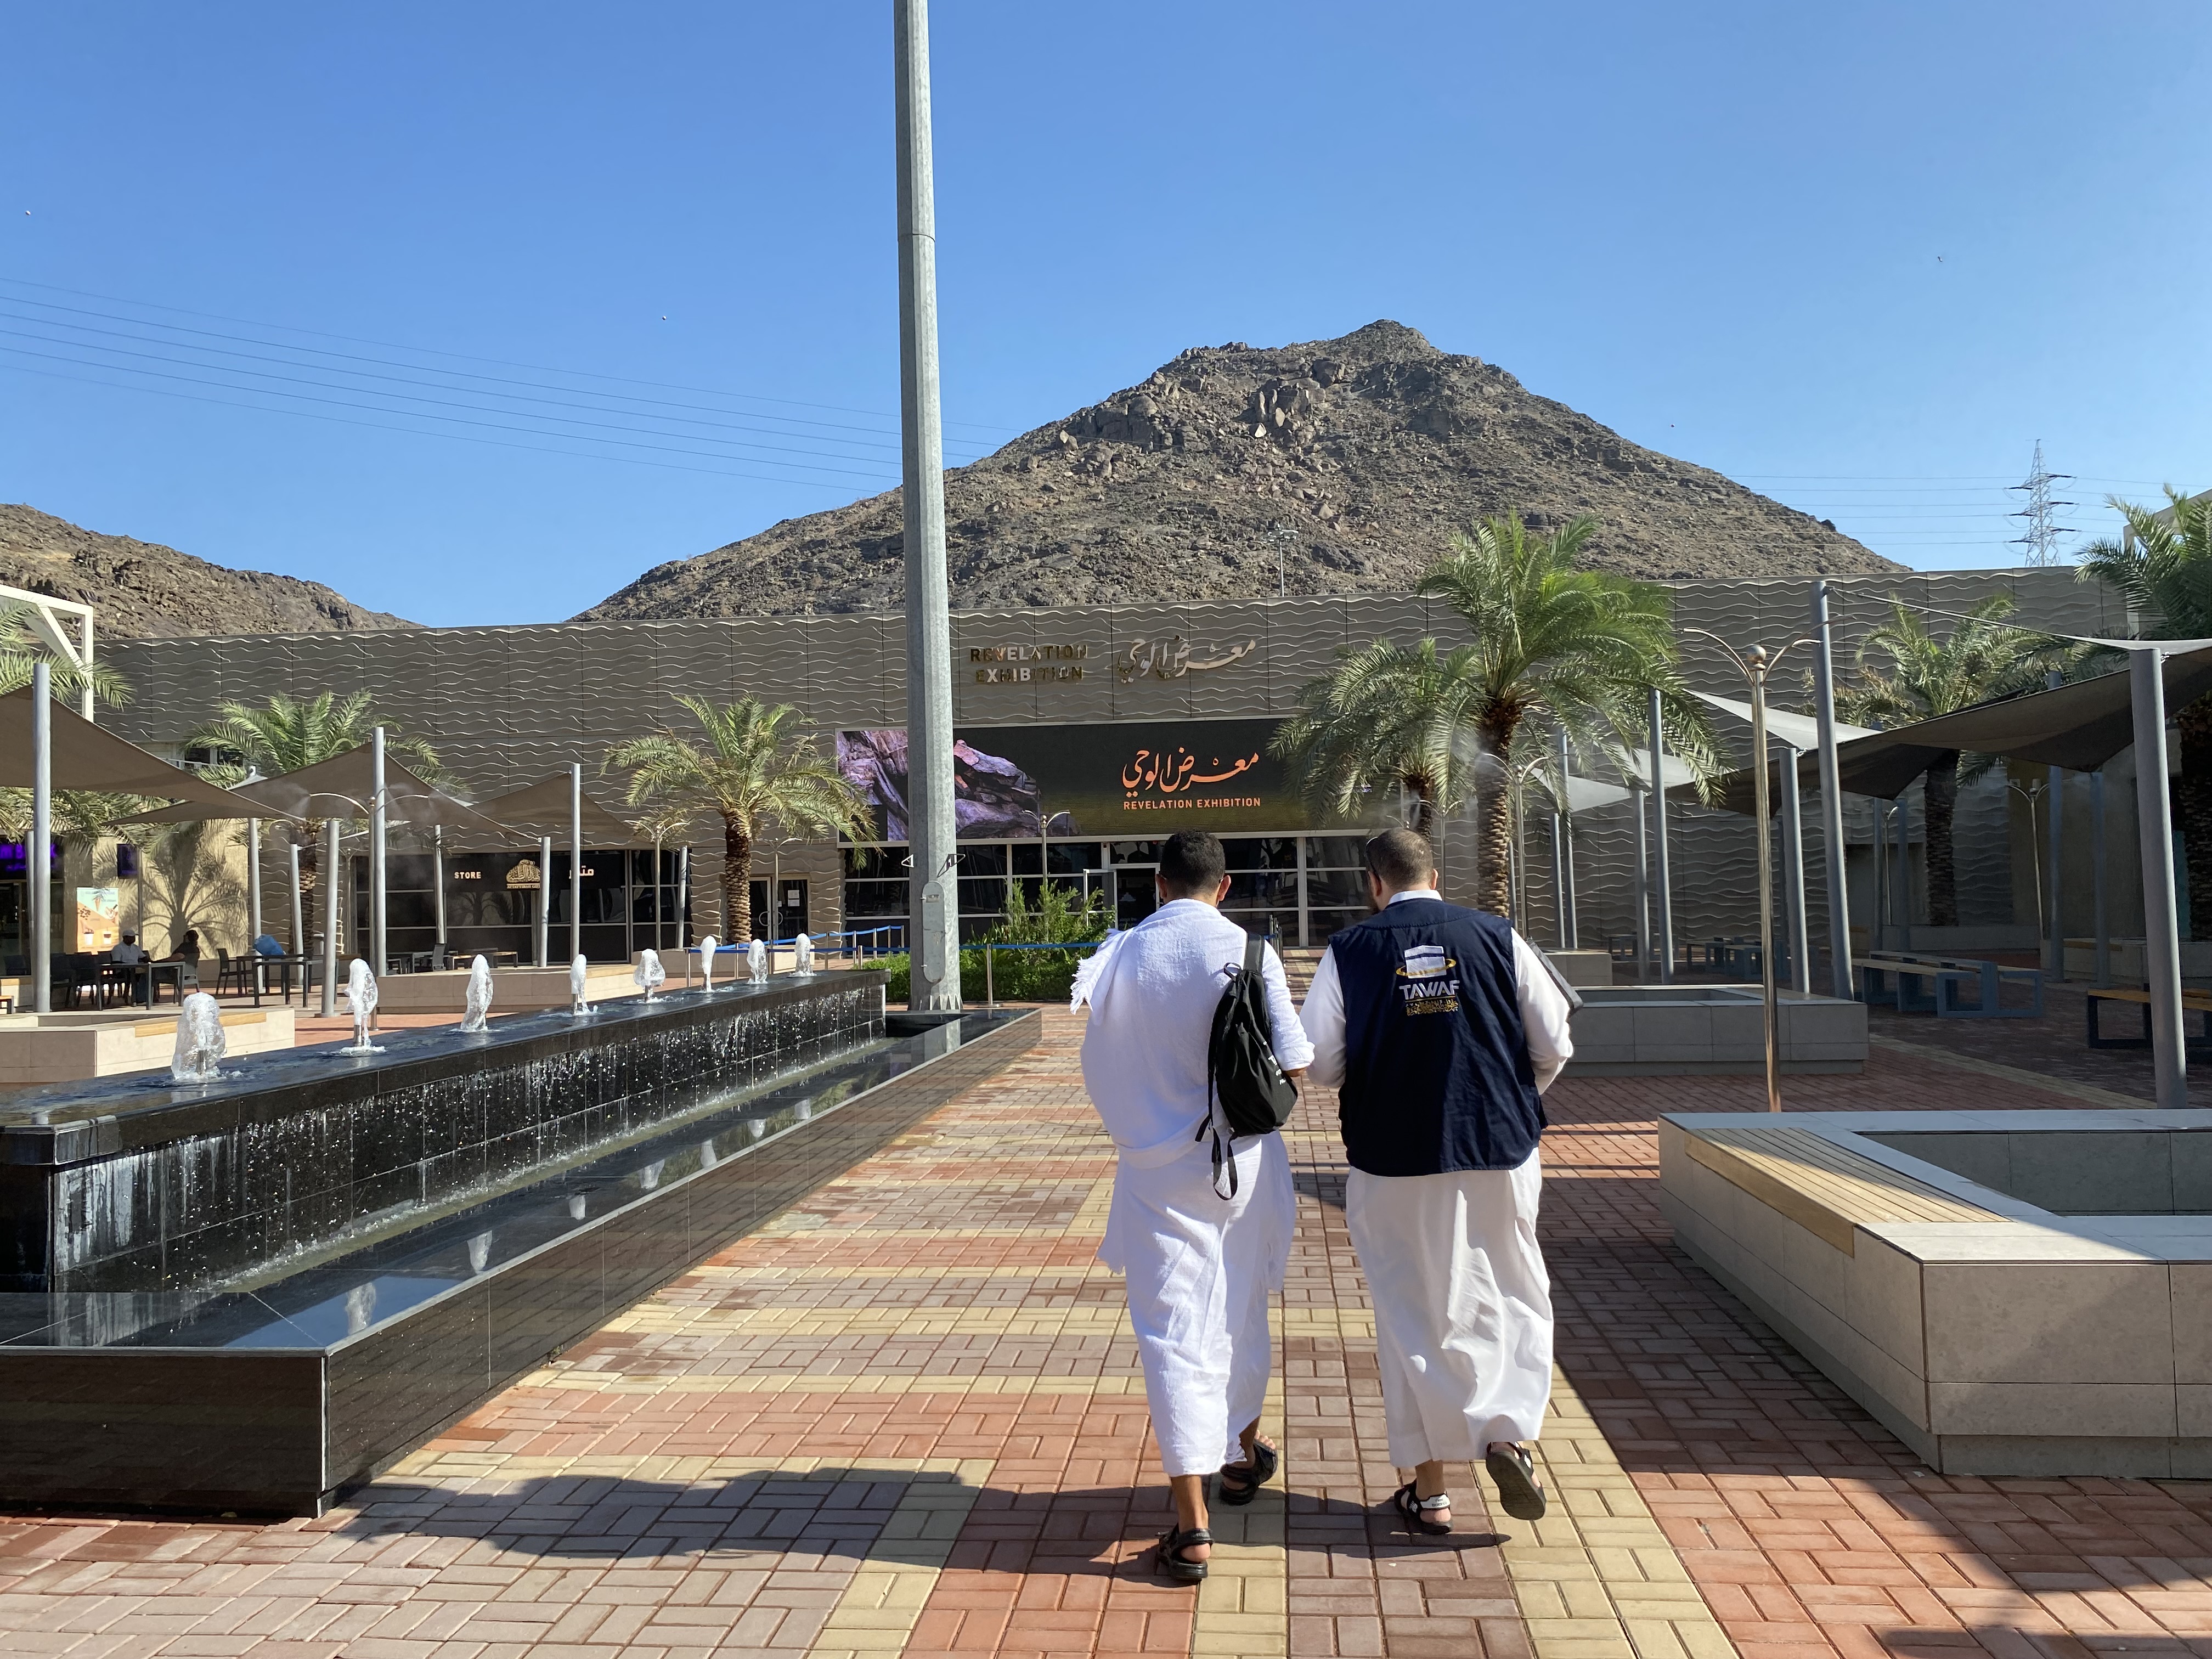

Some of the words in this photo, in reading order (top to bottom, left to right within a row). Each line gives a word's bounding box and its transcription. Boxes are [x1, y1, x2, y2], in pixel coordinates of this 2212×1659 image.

[970, 645, 1088, 663] REVELATION
[975, 666, 1084, 684] EXHIBITION
[1159, 746, 1259, 793] معرض
[1123, 799, 1193, 810] REVELATION
[1197, 797, 1261, 808] EXHIBITION
[454, 871, 482, 879] STORE
[1399, 980, 1460, 1000] TAWAF
